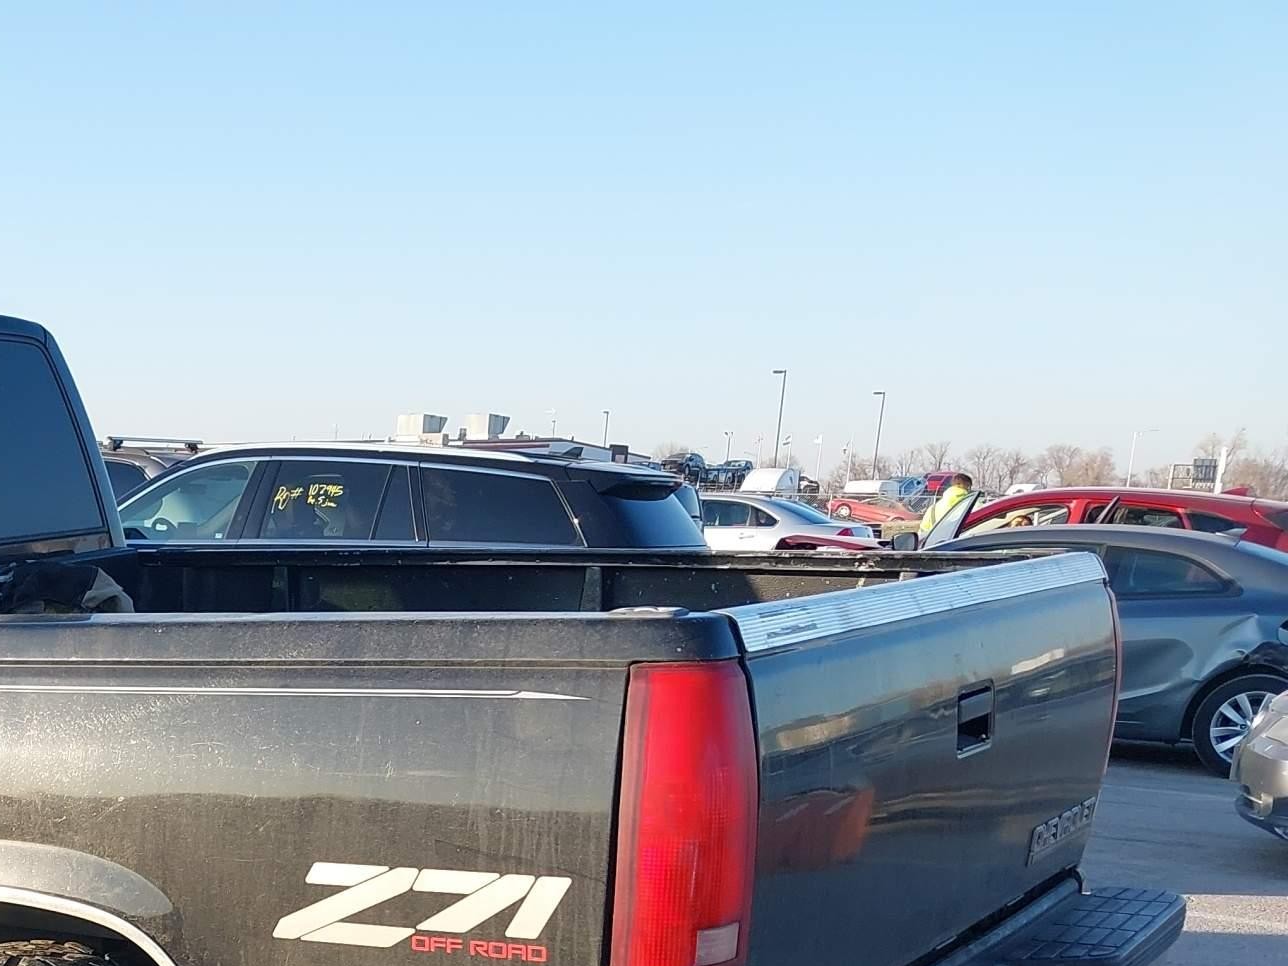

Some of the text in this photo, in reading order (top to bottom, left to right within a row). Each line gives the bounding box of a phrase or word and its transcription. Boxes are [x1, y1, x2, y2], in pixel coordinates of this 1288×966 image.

[272, 862, 572, 948] Z71
[411, 935, 548, 962] OFF ROAD
